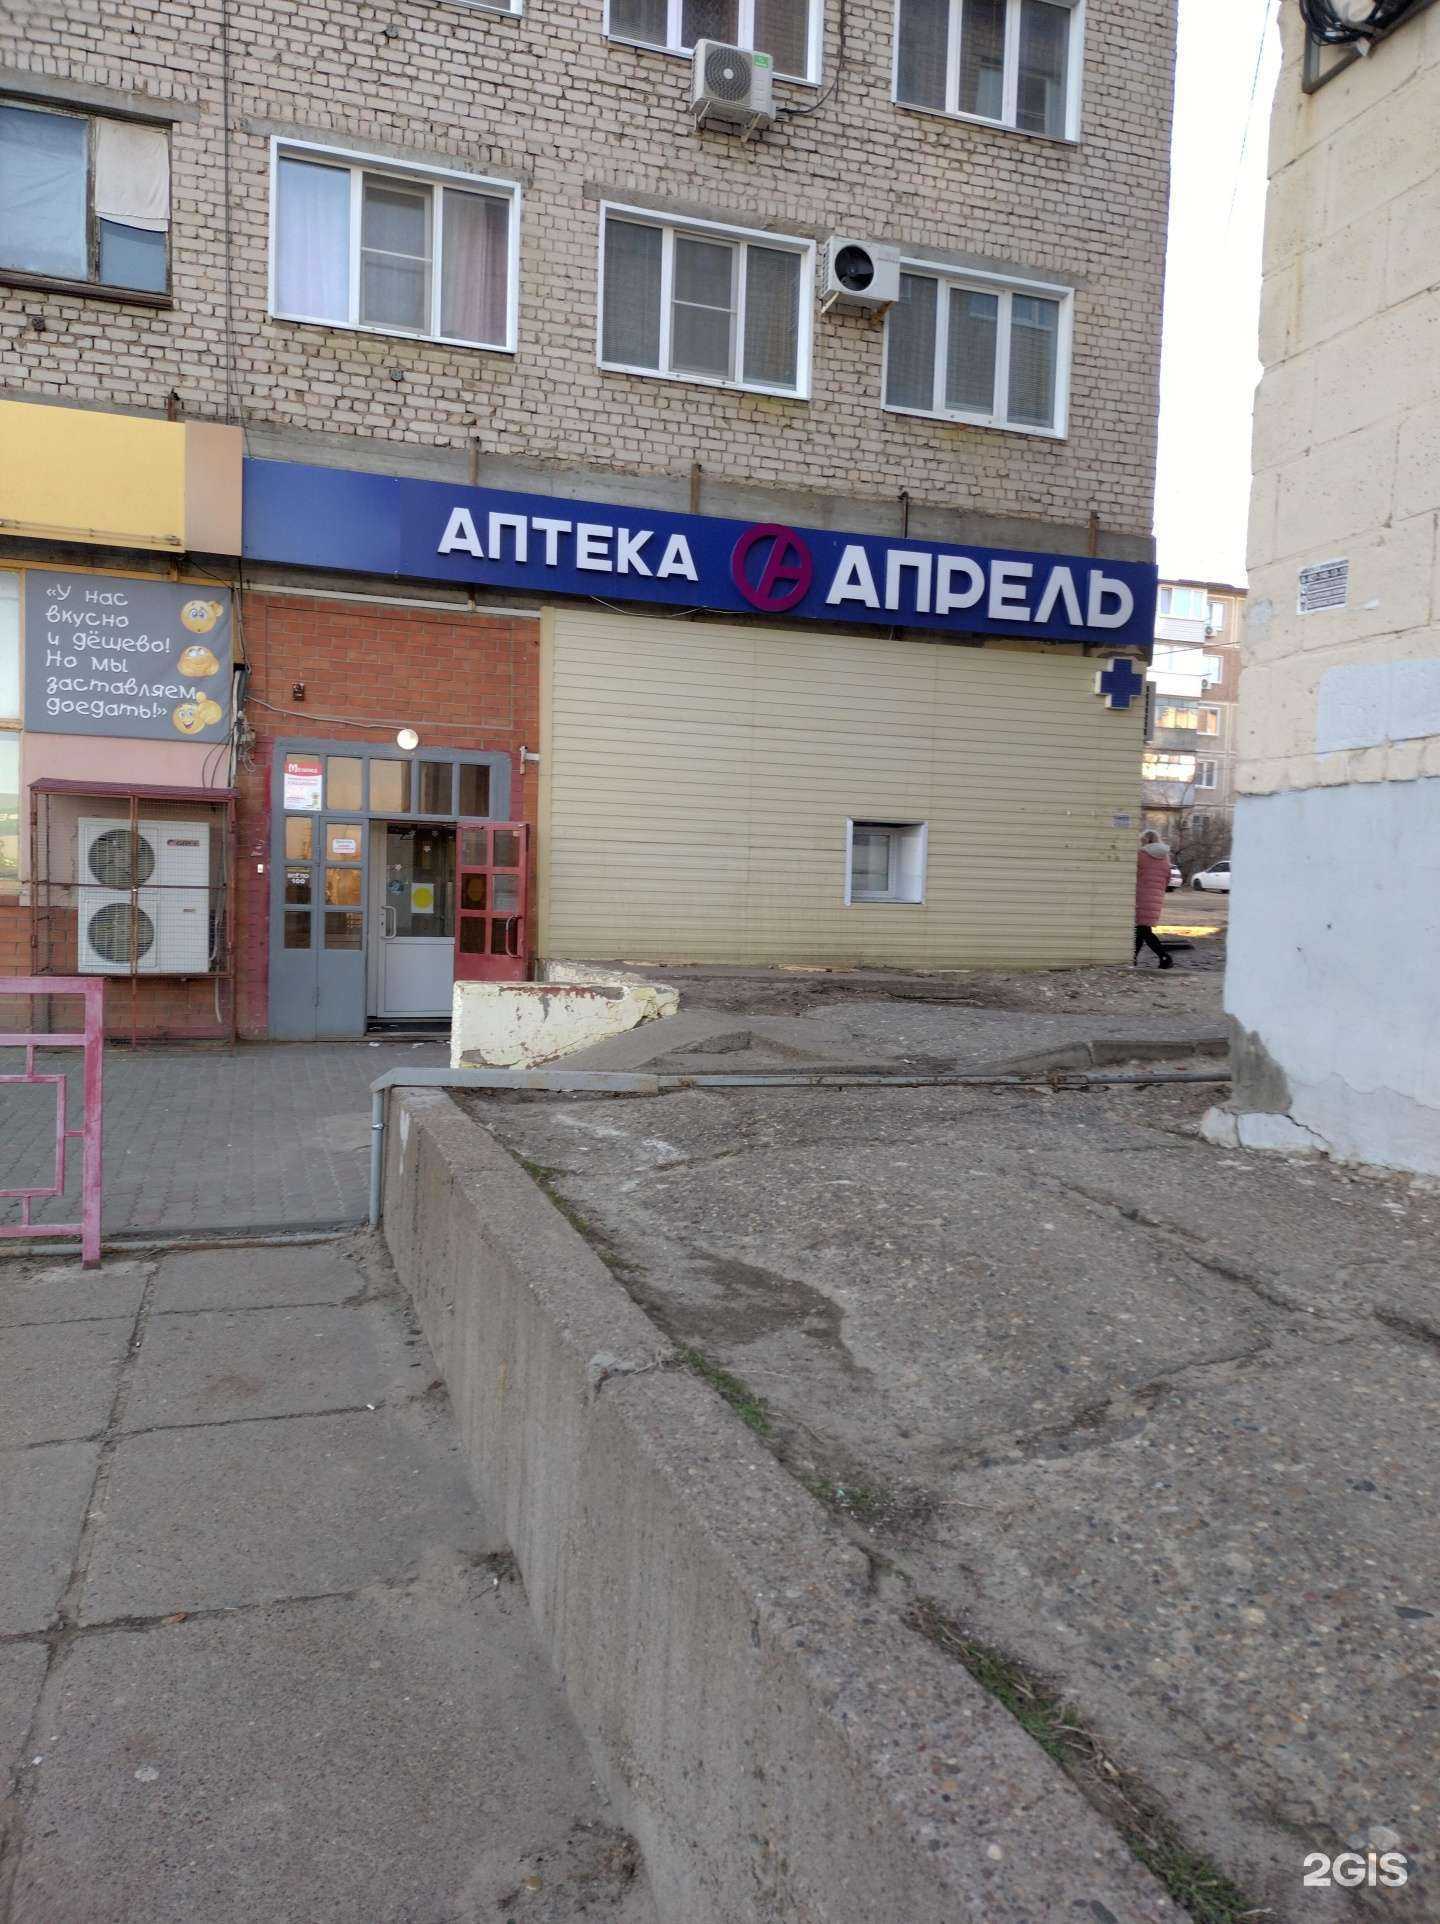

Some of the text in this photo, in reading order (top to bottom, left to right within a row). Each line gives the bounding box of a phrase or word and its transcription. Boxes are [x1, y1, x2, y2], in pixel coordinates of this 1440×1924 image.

[437, 507, 699, 582] АПТЕКА
[825, 544, 1135, 629] АПРЕЛЬ
[85, 590, 128, 606] нас
[45, 604, 129, 628] вкусно
[48, 630, 171, 653] и дёшево!
[46, 649, 129, 673] Но мы
[46, 676, 197, 700] заставляем
[46, 697, 168, 719] доедать!»
